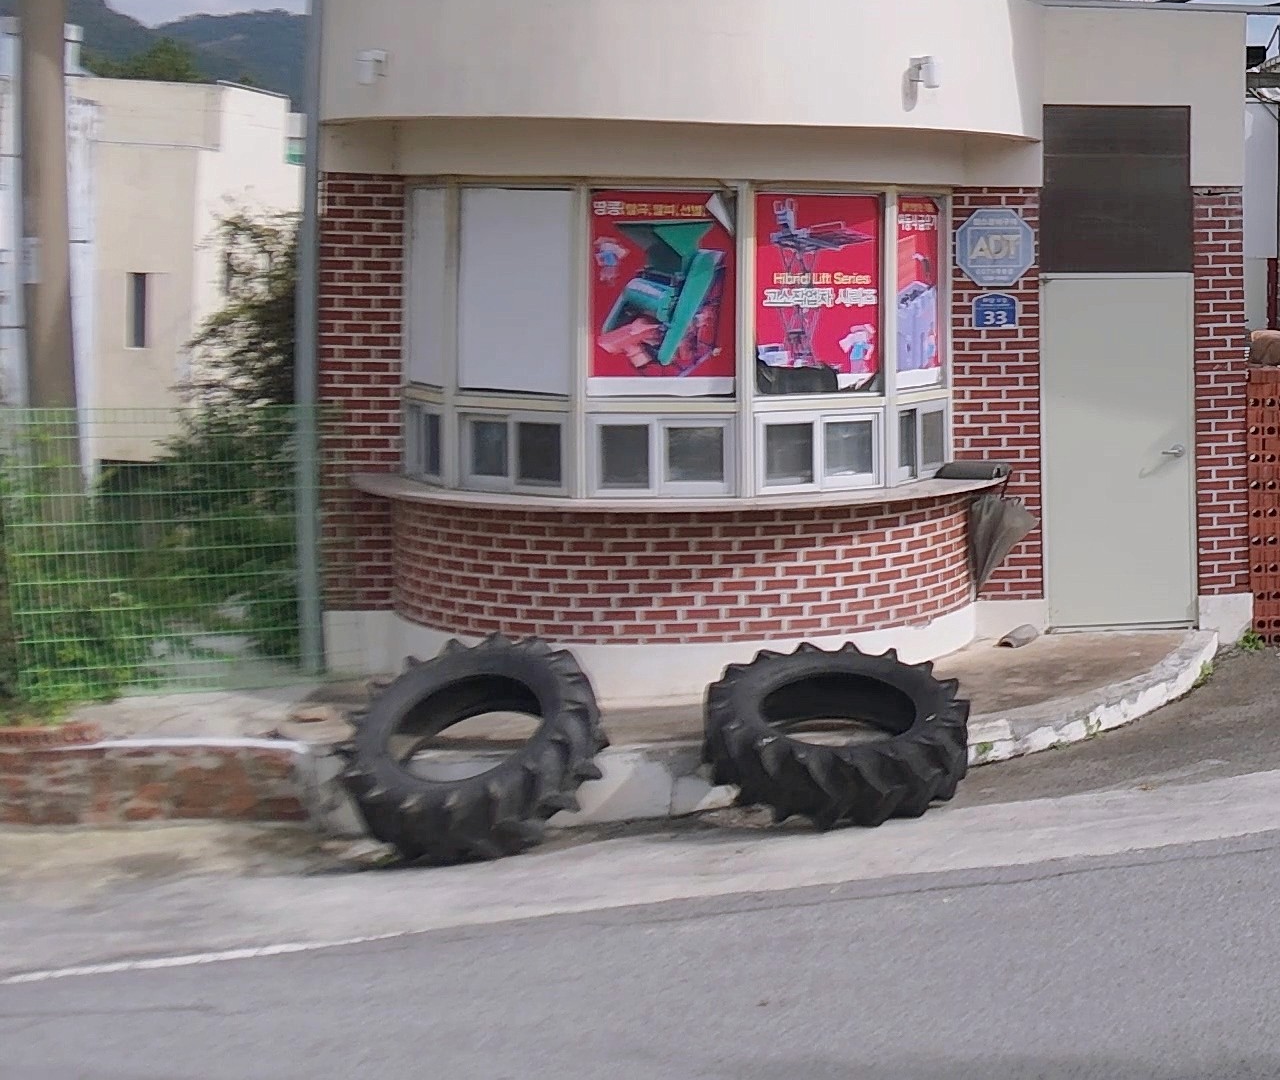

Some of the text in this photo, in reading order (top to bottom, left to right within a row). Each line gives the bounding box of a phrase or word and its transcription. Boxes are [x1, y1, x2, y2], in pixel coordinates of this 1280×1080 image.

[969, 234, 1021, 261] ADT
[812, 272, 833, 285] Lift
[833, 272, 872, 285] Series
[763, 288, 835, 308] 고소작업차
[983, 311, 1007, 325] 33
